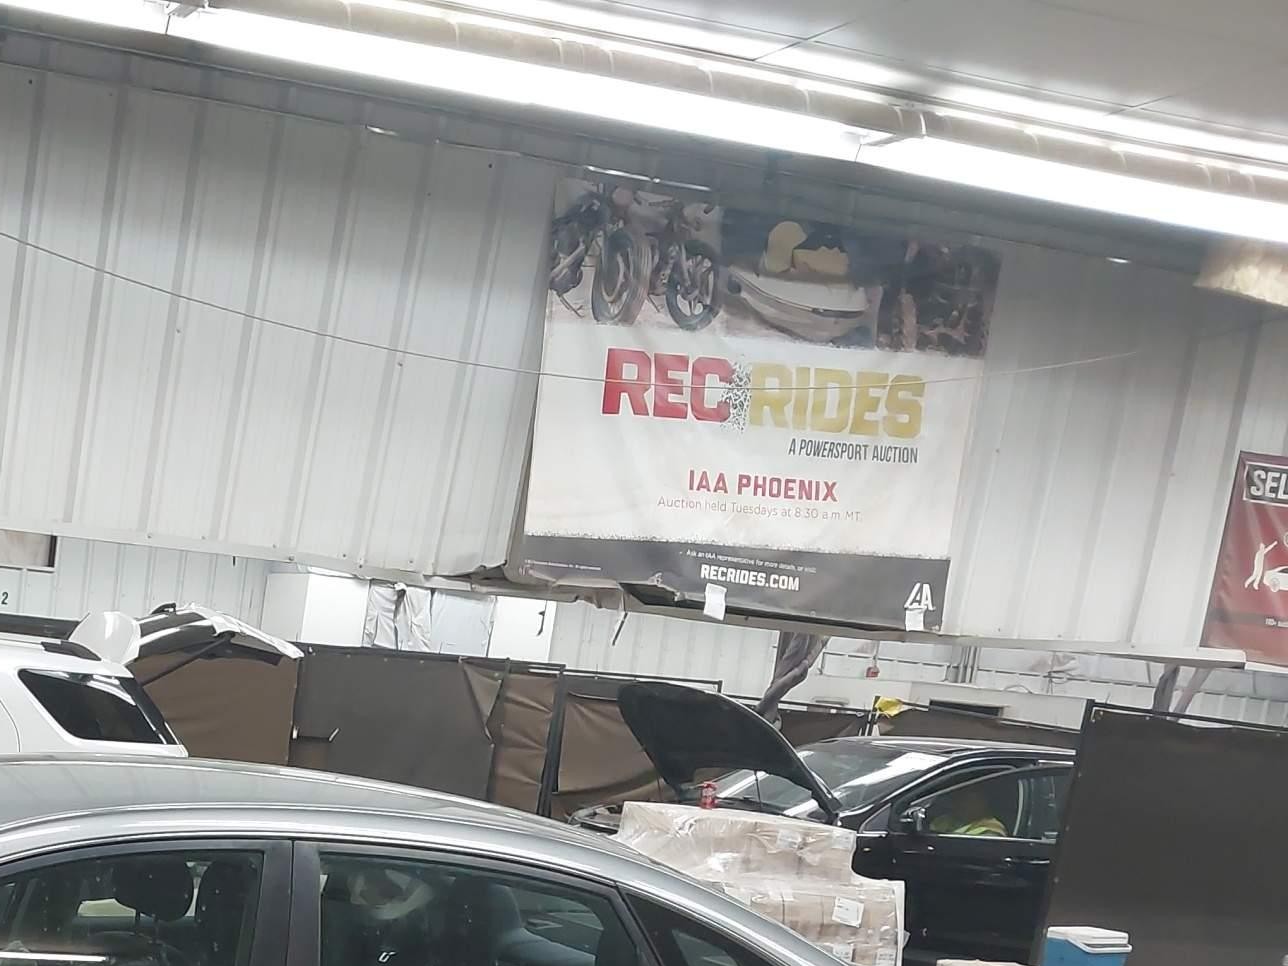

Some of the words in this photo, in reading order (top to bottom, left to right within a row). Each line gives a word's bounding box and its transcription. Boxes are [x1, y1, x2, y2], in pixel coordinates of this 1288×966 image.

[601, 347, 735, 424] REC
[748, 362, 926, 440] RIDES
[788, 438, 797, 455] A
[799, 438, 870, 461] POWERSPORT
[871, 445, 919, 464] AUCTION
[688, 469, 728, 494] IAA
[737, 474, 838, 502] PHOENIX
[657, 496, 702, 509] Auction
[704, 499, 727, 512] held
[731, 502, 778, 518] Tuesdays
[781, 508, 792, 518] at
[700, 563, 800, 592] RECRIDES.COM
[1, 591, 9, 605] 2
